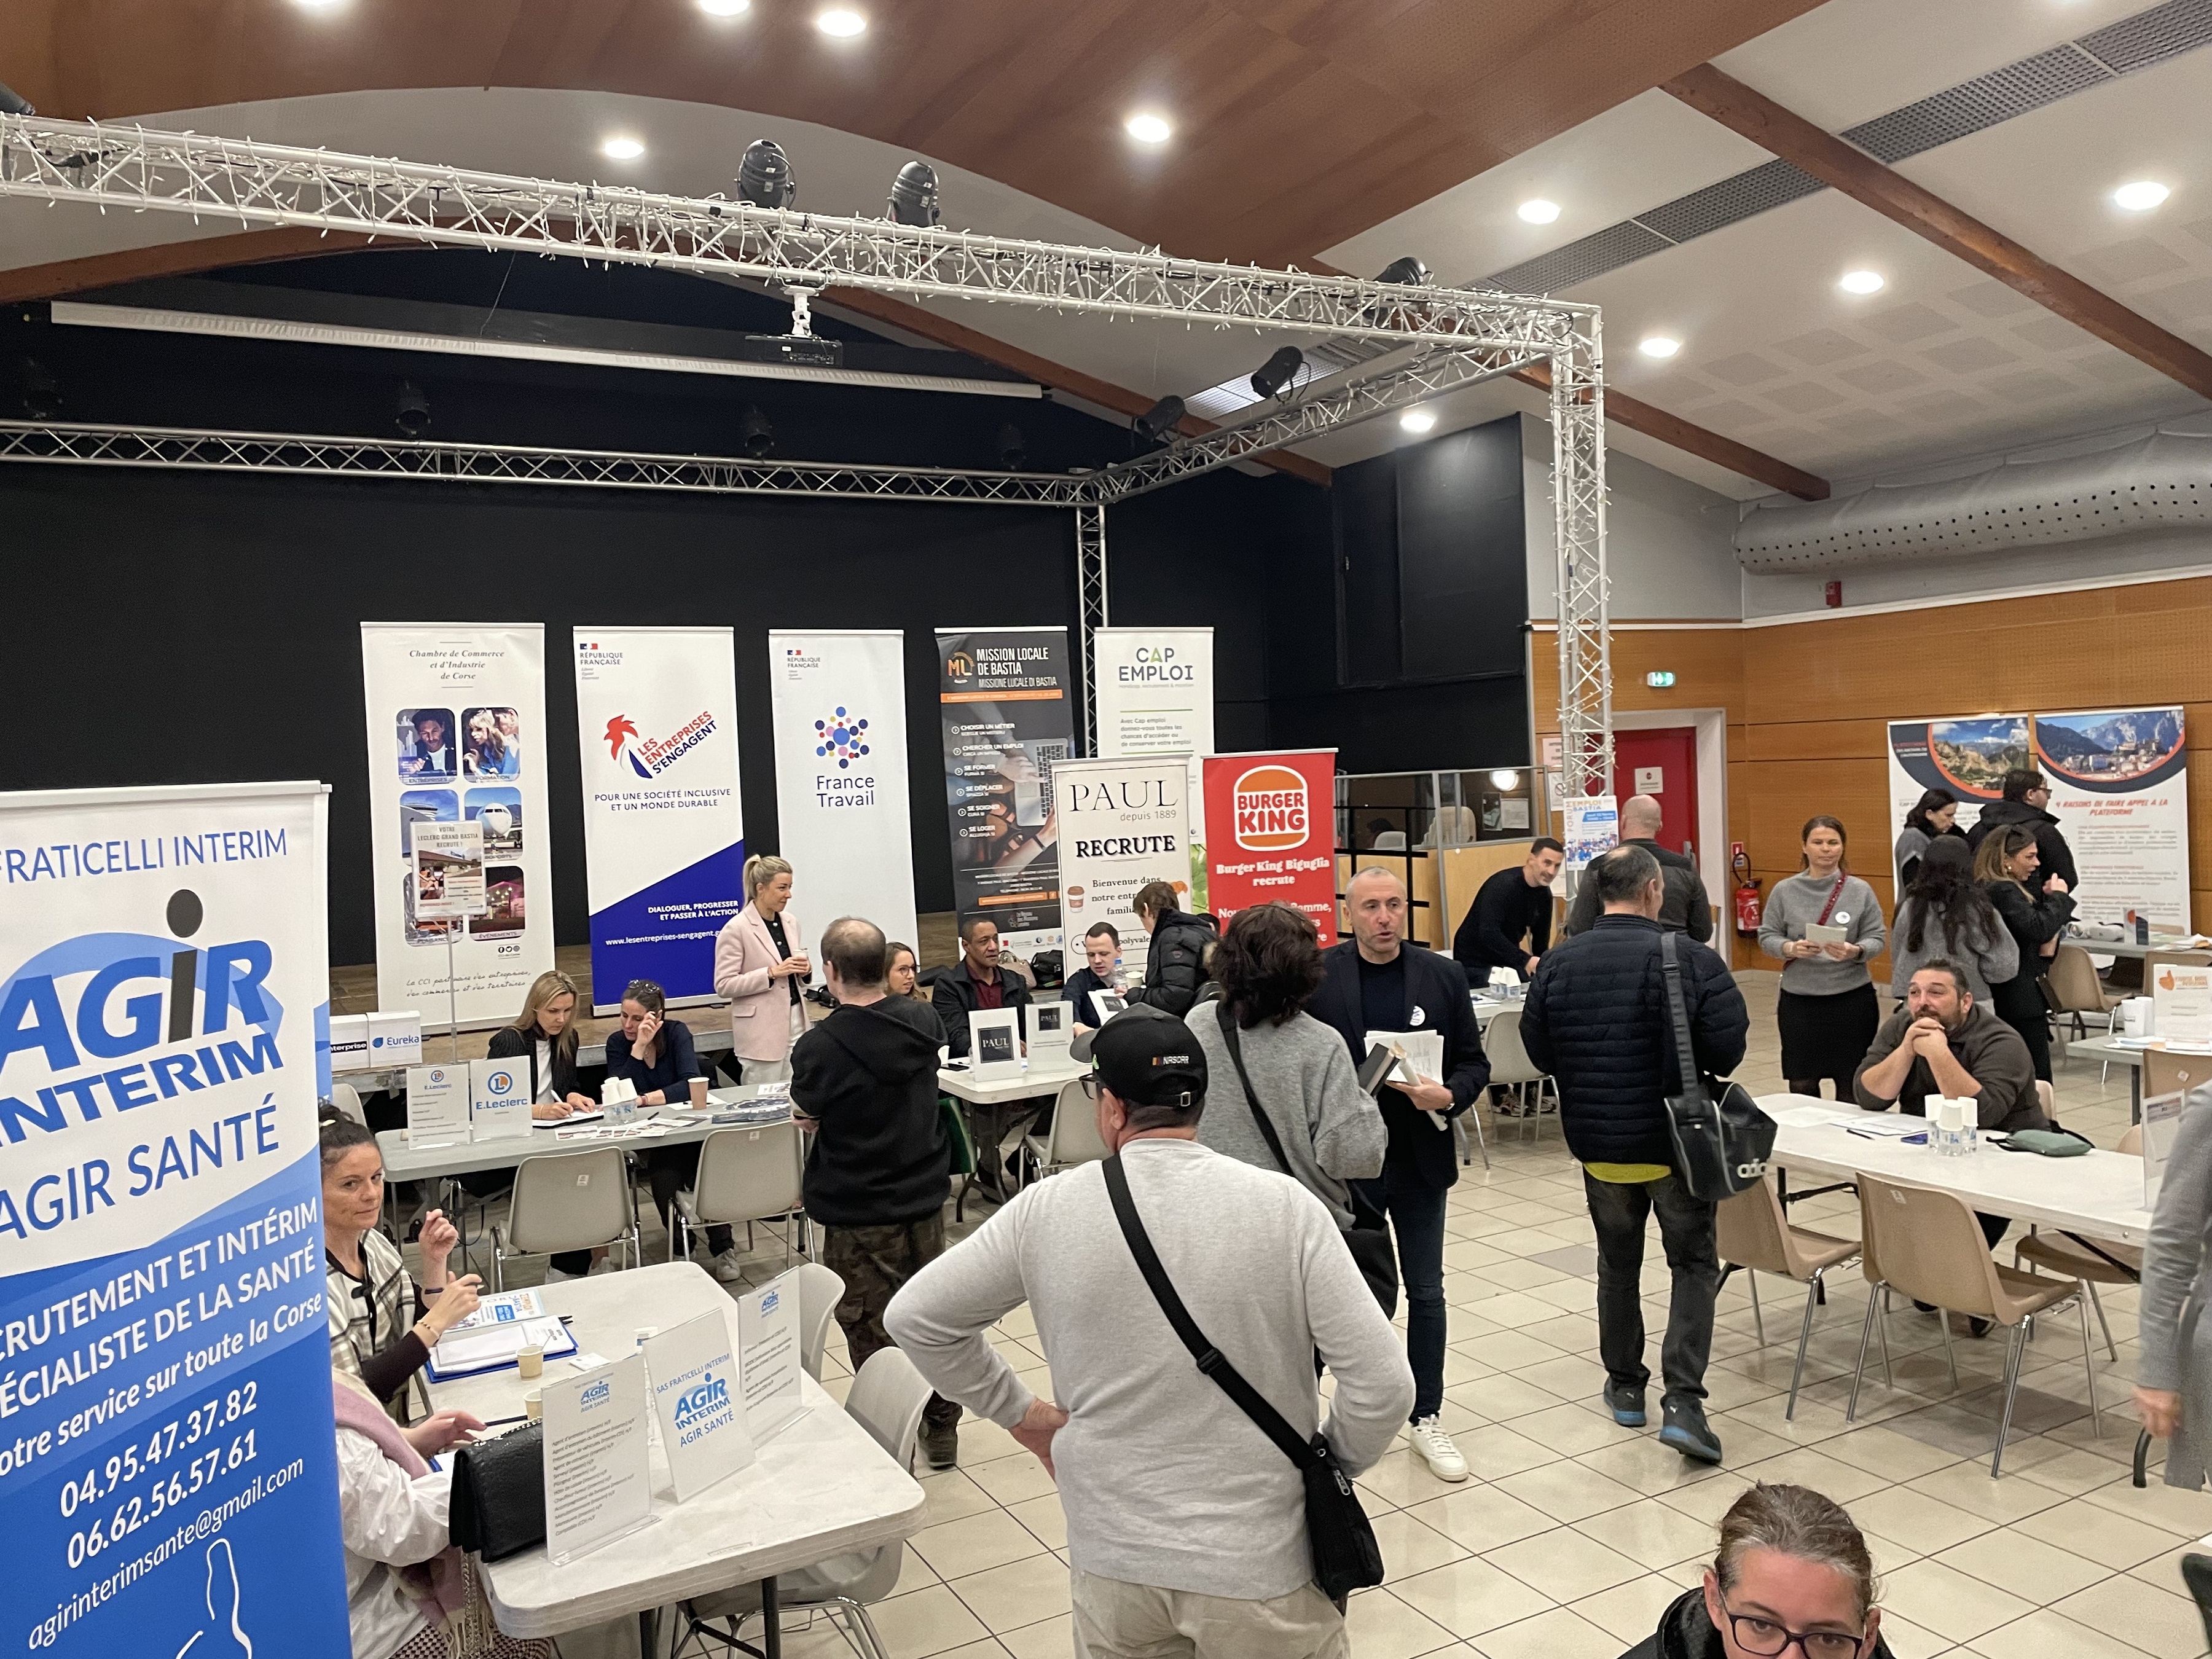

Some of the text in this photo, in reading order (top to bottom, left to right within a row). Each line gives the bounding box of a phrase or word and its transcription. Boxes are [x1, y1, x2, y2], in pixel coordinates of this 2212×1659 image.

[409, 649, 447, 658] Chambre
[976, 647, 1049, 662] MISSION LOCALE
[1136, 647, 1174, 663] CAP
[439, 661, 485, 669] d'Industrie
[948, 659, 973, 677] ML
[978, 662, 1023, 676] DE BASTIA
[1119, 665, 1193, 681] EMPLOI
[1036, 677, 1057, 687] BASTIA
[645, 711, 712, 766] ENTREPRISES
[637, 738, 658, 756] LES
[652, 720, 717, 774] S'ENGAGENT
[817, 775, 875, 790] France
[594, 794, 621, 803] POUR
[644, 790, 682, 799] SOCIÉTÉ
[684, 788, 731, 798] INCLUSIVE
[816, 790, 874, 807] Travail
[1069, 780, 1179, 812] PAUL
[1237, 792, 1304, 810] BURGER
[641, 801, 676, 810] MONDE
[678, 799, 718, 808] DURABLE
[1120, 809, 1177, 822] depuis 1889
[1238, 809, 1305, 833] KING
[1075, 834, 1176, 858] RECRUTE
[0, 828, 287, 884] RATICELLI INTERIM
[1215, 857, 1330, 876] Burger King Biguglia
[1092, 879, 1139, 888] Bienvenue
[1252, 874, 1295, 887] recrute
[1091, 893, 1116, 902] notre
[648, 900, 739, 914] DIALOGUER, PROGRESSER
[670, 912, 697, 920] PASSER
[698, 909, 704, 918] À
[705, 908, 739, 917] L'ACTION
[1107, 906, 1135, 915] famili
[605, 930, 721, 946] www.lesentreprises-sengagent.g
[422, 987, 460, 995] commeres
[330, 1043, 367, 1052] nterprise
[386, 1035, 420, 1046] Eureka
[982, 1037, 1010, 1048] PAUL
[1163, 1056, 1189, 1065] NASCAR
[0, 1033, 283, 1148] NTERIM
[476, 1098, 528, 1110] E.Leclerc
[128, 1093, 280, 1198] SANTÉ
[179, 1240, 212, 1281] ET
[217, 1196, 318, 1266] INTÉRIM
[154, 1296, 192, 1342] DE
[197, 1282, 234, 1323] LA
[238, 1241, 316, 1304] SANTÉ
[58, 1388, 140, 1447] service
[146, 1370, 181, 1401] sur
[184, 1332, 245, 1384] toute
[249, 1317, 268, 1349] la
[272, 1293, 322, 1333] Corse
[656, 1353, 730, 1394] SAS FRATICELLI INTERIM
[675, 1396, 731, 1430] INTERIM
[680, 1407, 734, 1448] AGIR SANTÉ
[60, 1381, 258, 1518] 04.95.47.37.82
[67, 1429, 257, 1569] 06.62.56.57.61
[28, 1456, 304, 1650] agirinterimsante@gmail.com
